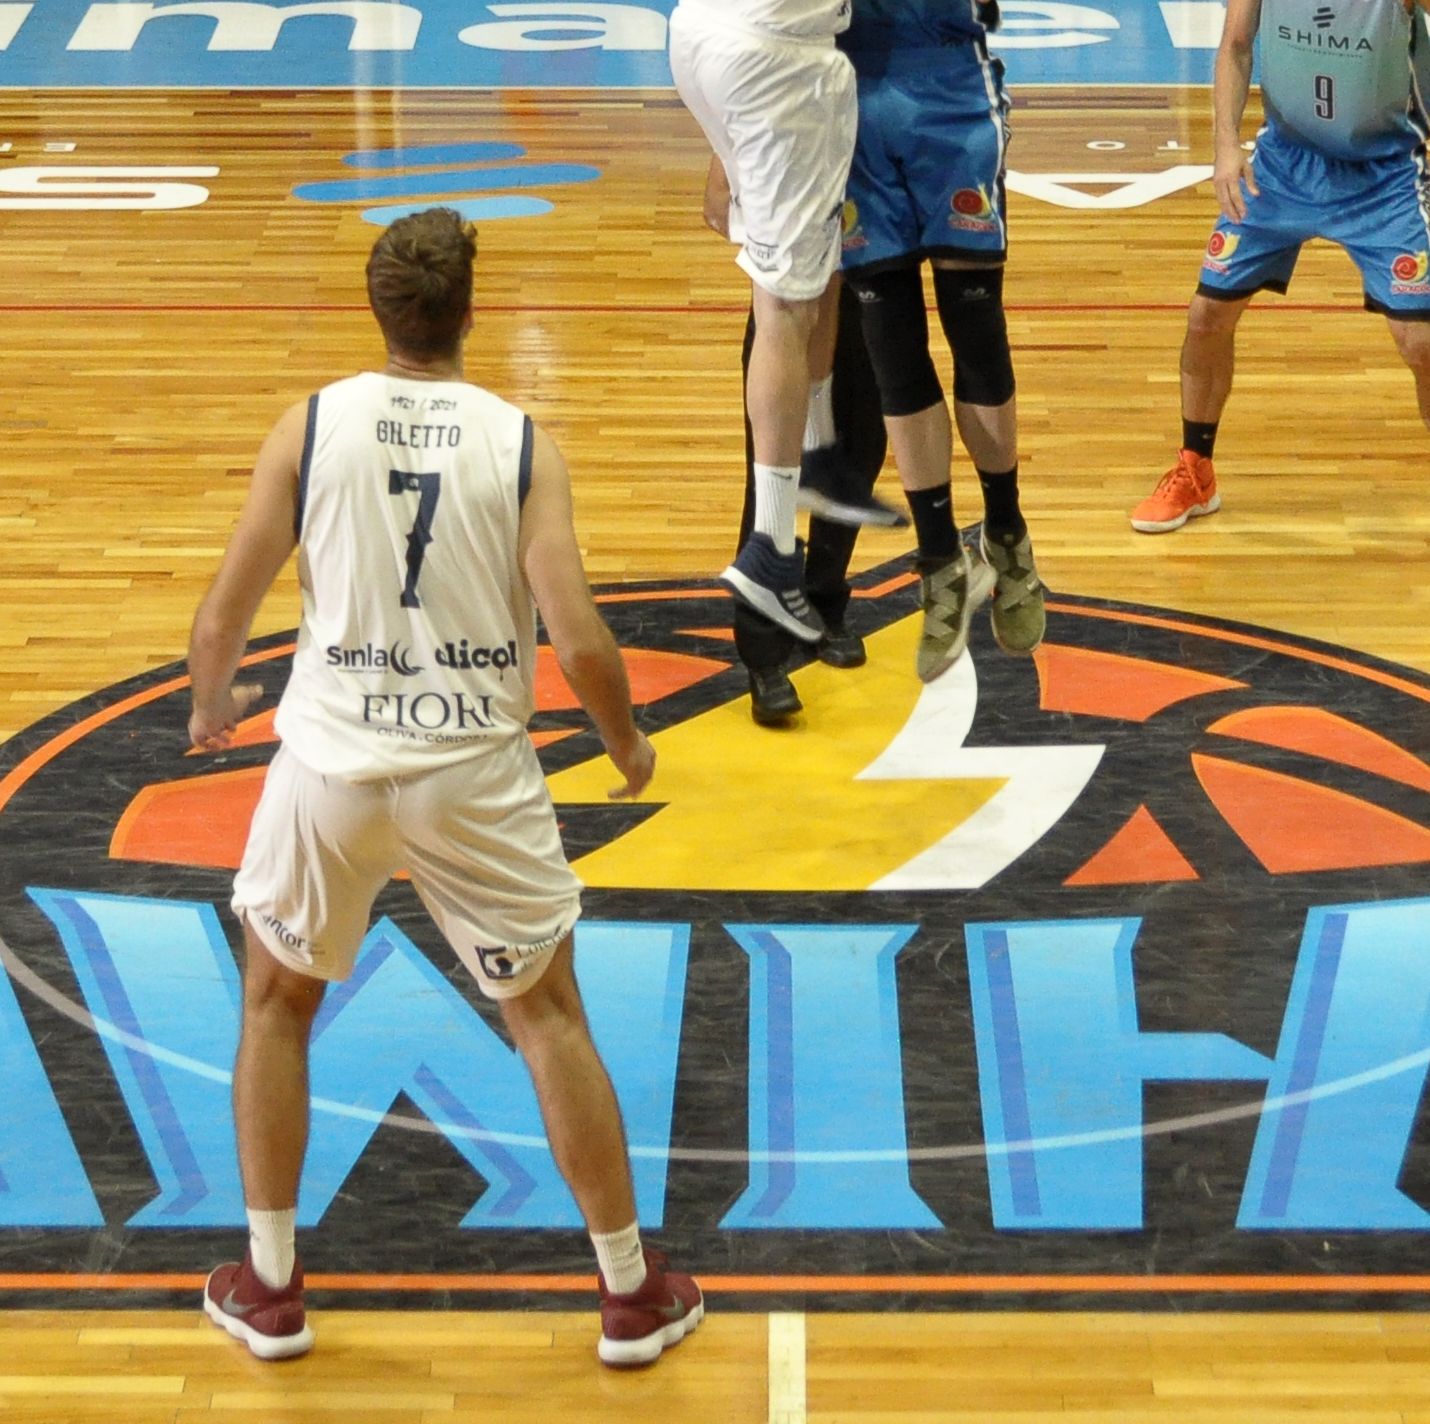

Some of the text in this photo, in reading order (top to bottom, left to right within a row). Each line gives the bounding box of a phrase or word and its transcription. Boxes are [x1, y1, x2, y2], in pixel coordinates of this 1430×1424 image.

[1278, 25, 1374, 53] SHIMA
[1311, 73, 1337, 121] 9
[429, 398, 458, 412] 2021
[387, 470, 443, 609] 7
[360, 692, 498, 730] FIORI
